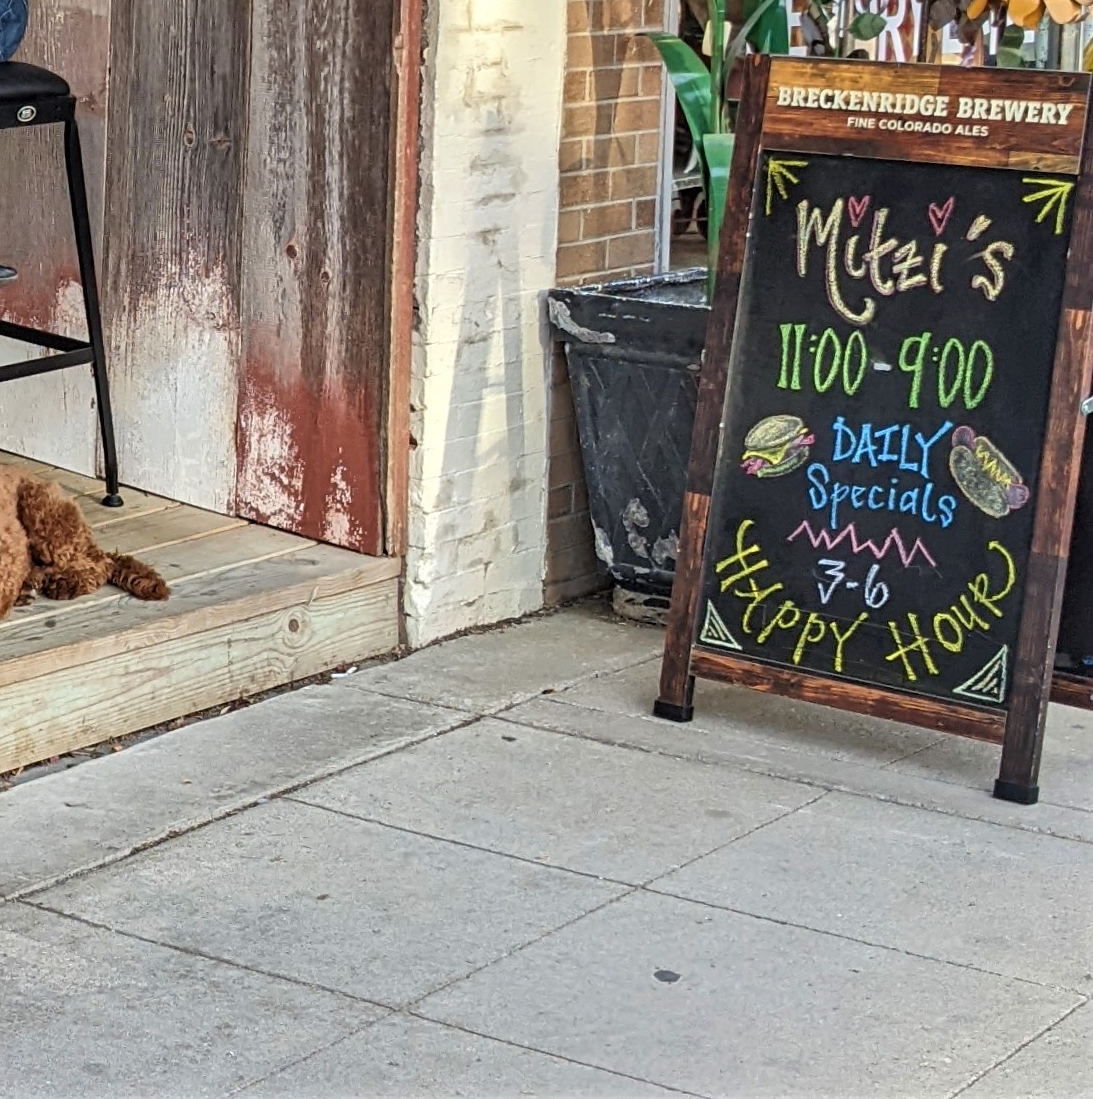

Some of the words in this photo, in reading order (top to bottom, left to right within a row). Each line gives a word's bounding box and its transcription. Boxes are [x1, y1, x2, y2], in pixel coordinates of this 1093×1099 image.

[777, 86, 950, 117] BRECKENRIDGE
[956, 97, 1073, 125] BREWERY
[847, 116, 875, 129] FINE
[878, 119, 952, 135] COLORADO
[955, 124, 989, 137] ALES
[796, 196, 1016, 325] Mitzi's
[832, 415, 954, 479] DAILY
[806, 462, 957, 530] Specials
[817, 558, 890, 609] 3-6
